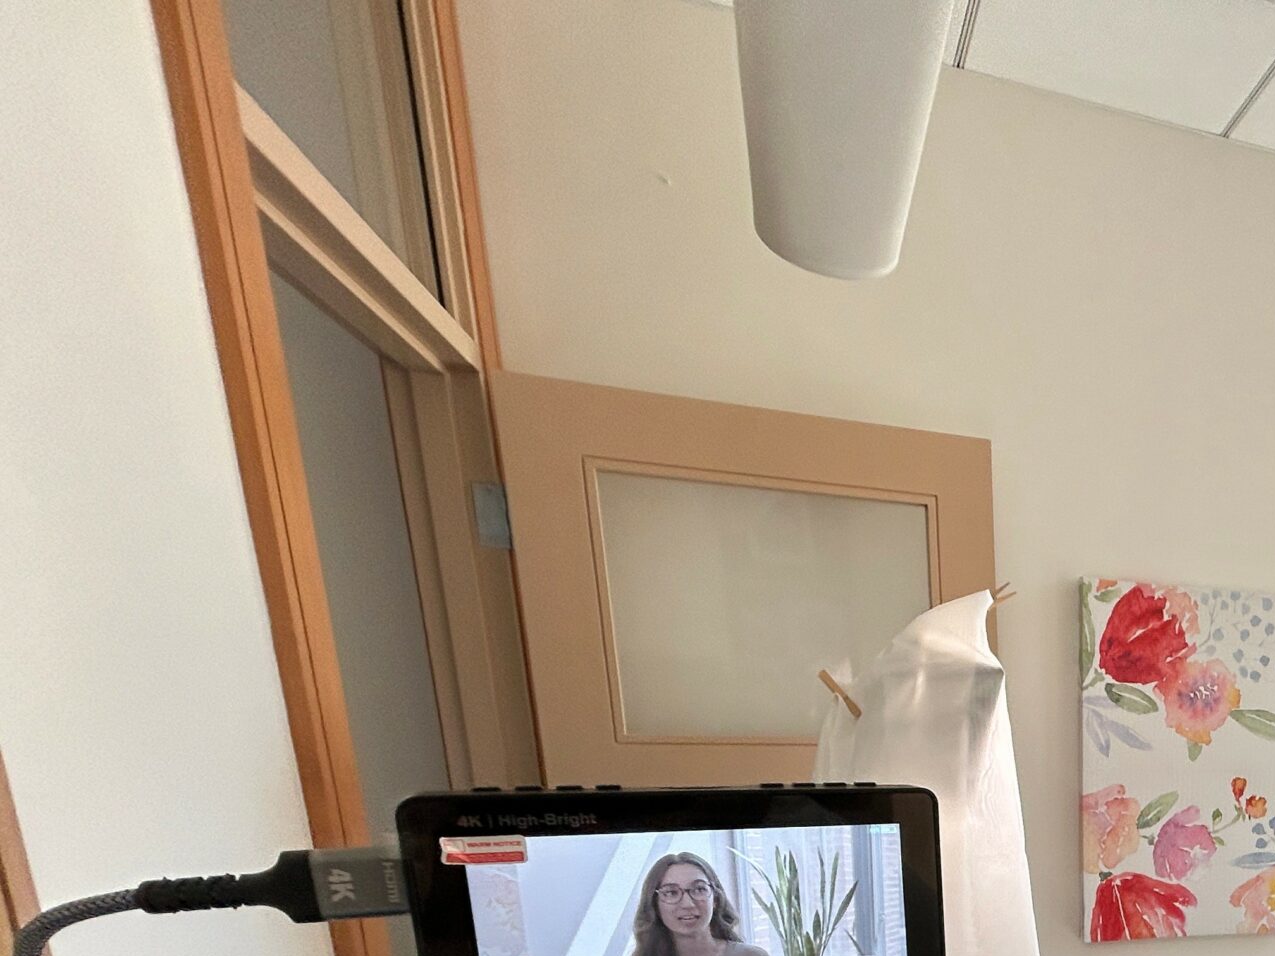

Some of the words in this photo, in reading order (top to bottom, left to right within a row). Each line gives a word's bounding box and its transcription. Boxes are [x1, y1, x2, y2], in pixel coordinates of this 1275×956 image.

[456, 814, 482, 828] 4K
[498, 811, 598, 829] High-Bright
[328, 867, 356, 902] 4K
[382, 862, 400, 904] HDMI
